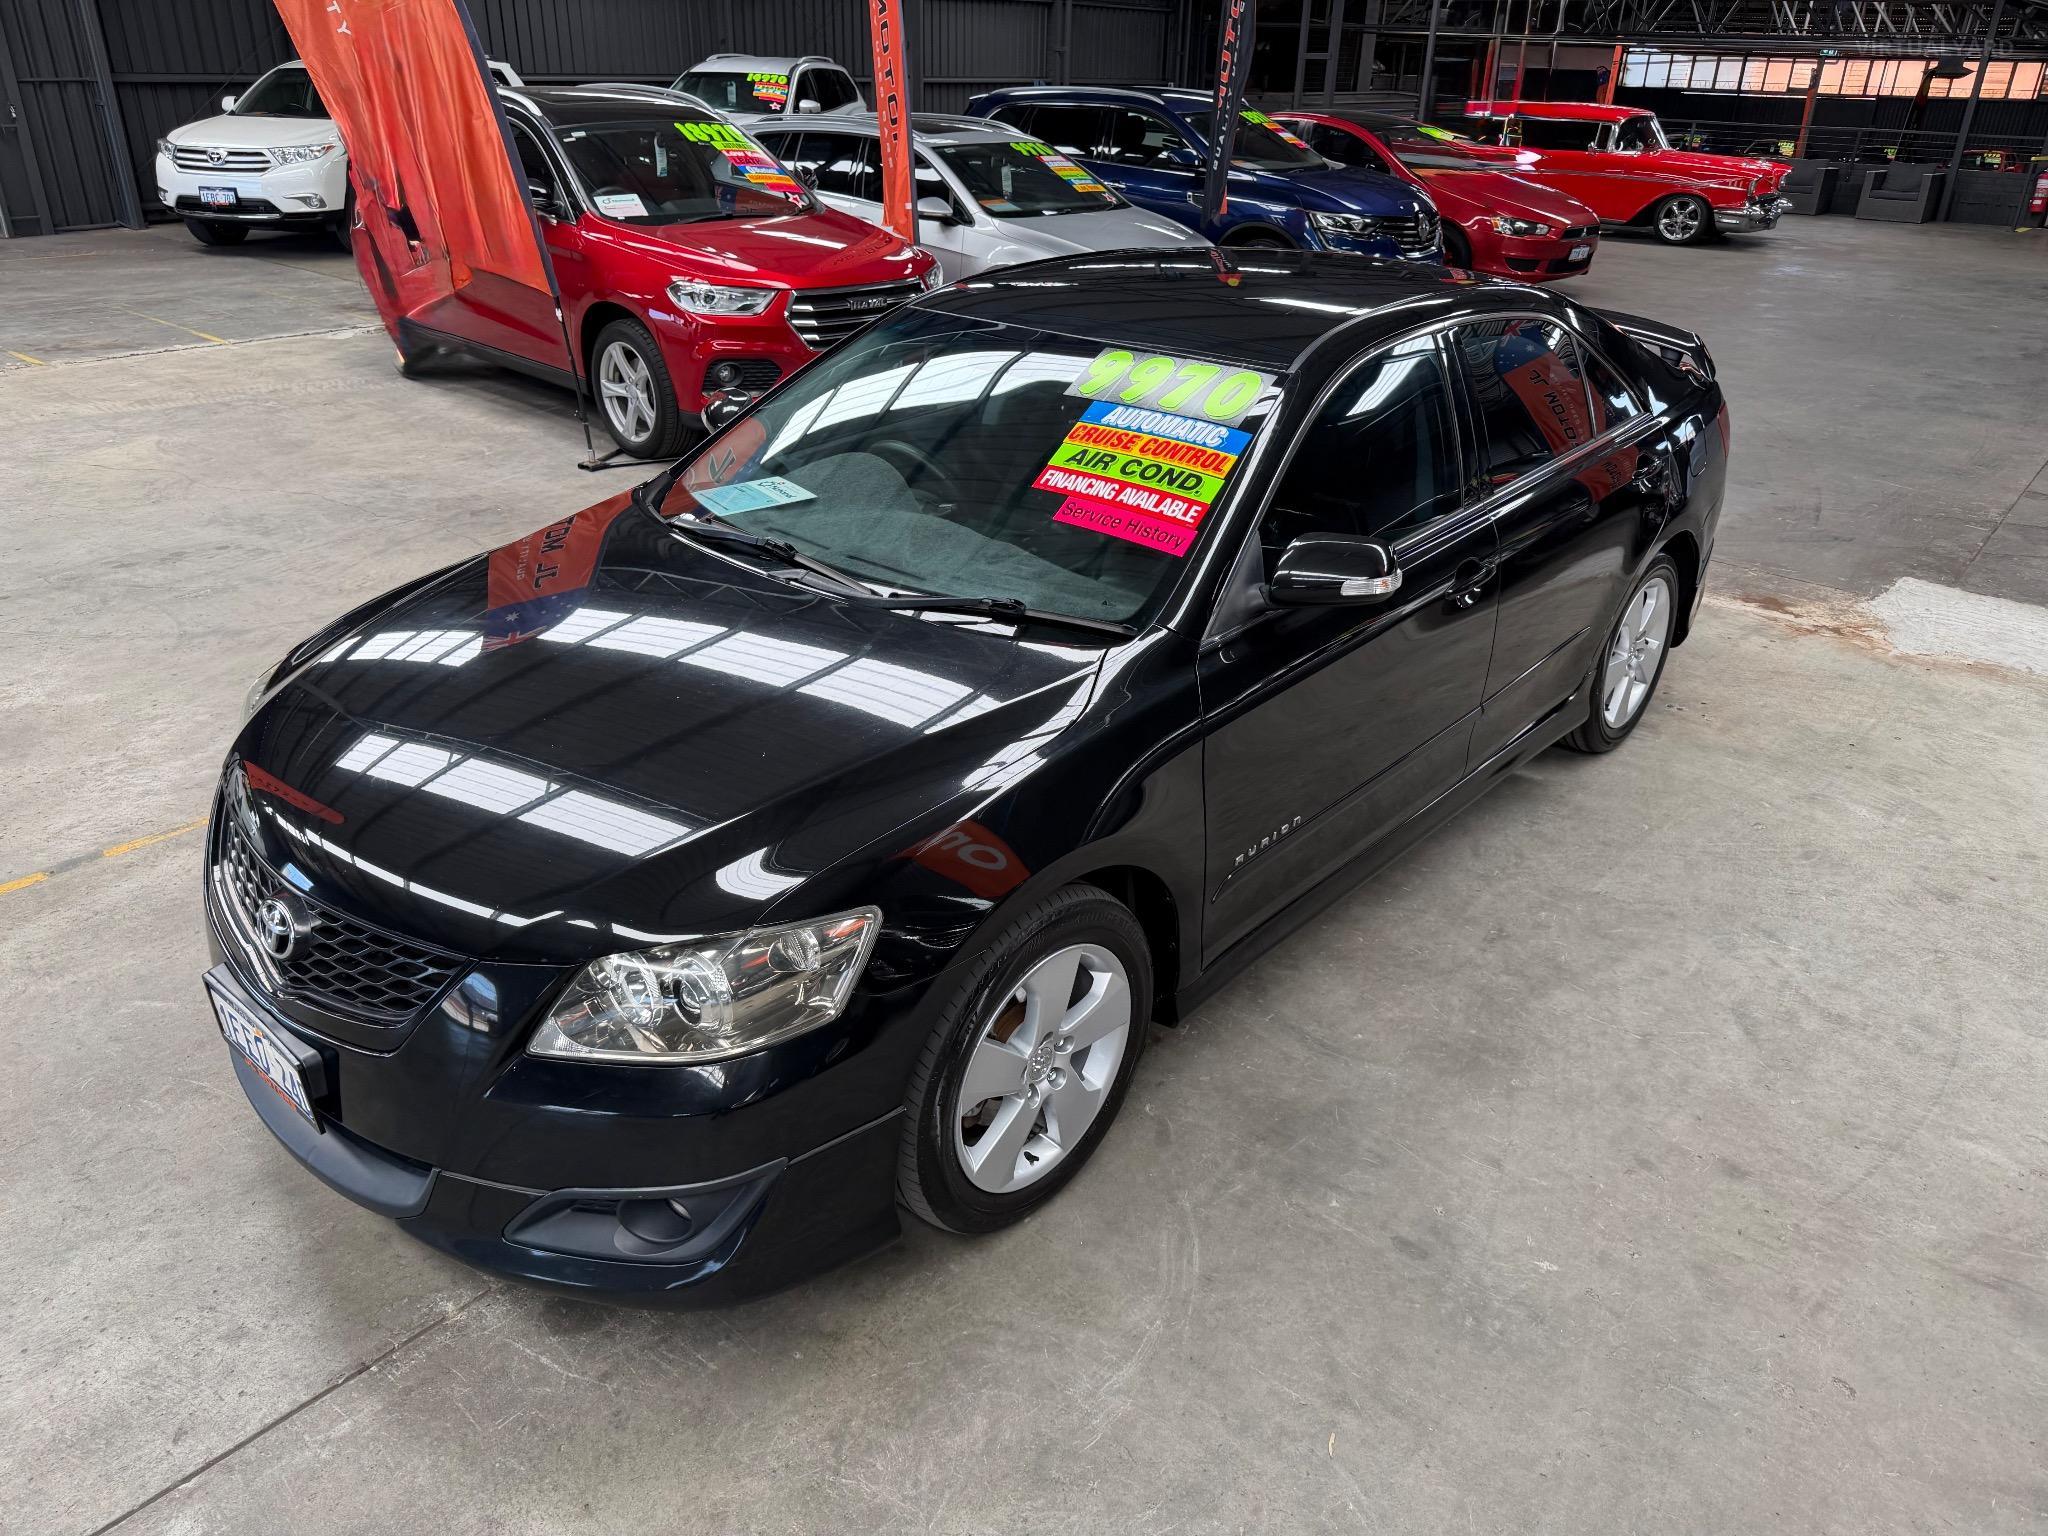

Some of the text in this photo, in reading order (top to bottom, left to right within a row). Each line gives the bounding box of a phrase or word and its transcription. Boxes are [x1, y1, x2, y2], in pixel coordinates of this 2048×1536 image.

[1077, 351, 1264, 420] 9970
[1067, 424, 1233, 474] CRUISE CONTROL
[1101, 406, 1230, 448] AUTOMATIC
[1063, 447, 1204, 496] AIR COND.
[1039, 469, 1203, 525] FINANCING AVAILABLE
[1061, 502, 1187, 549] Service History
[1234, 815, 1302, 867] AURION
